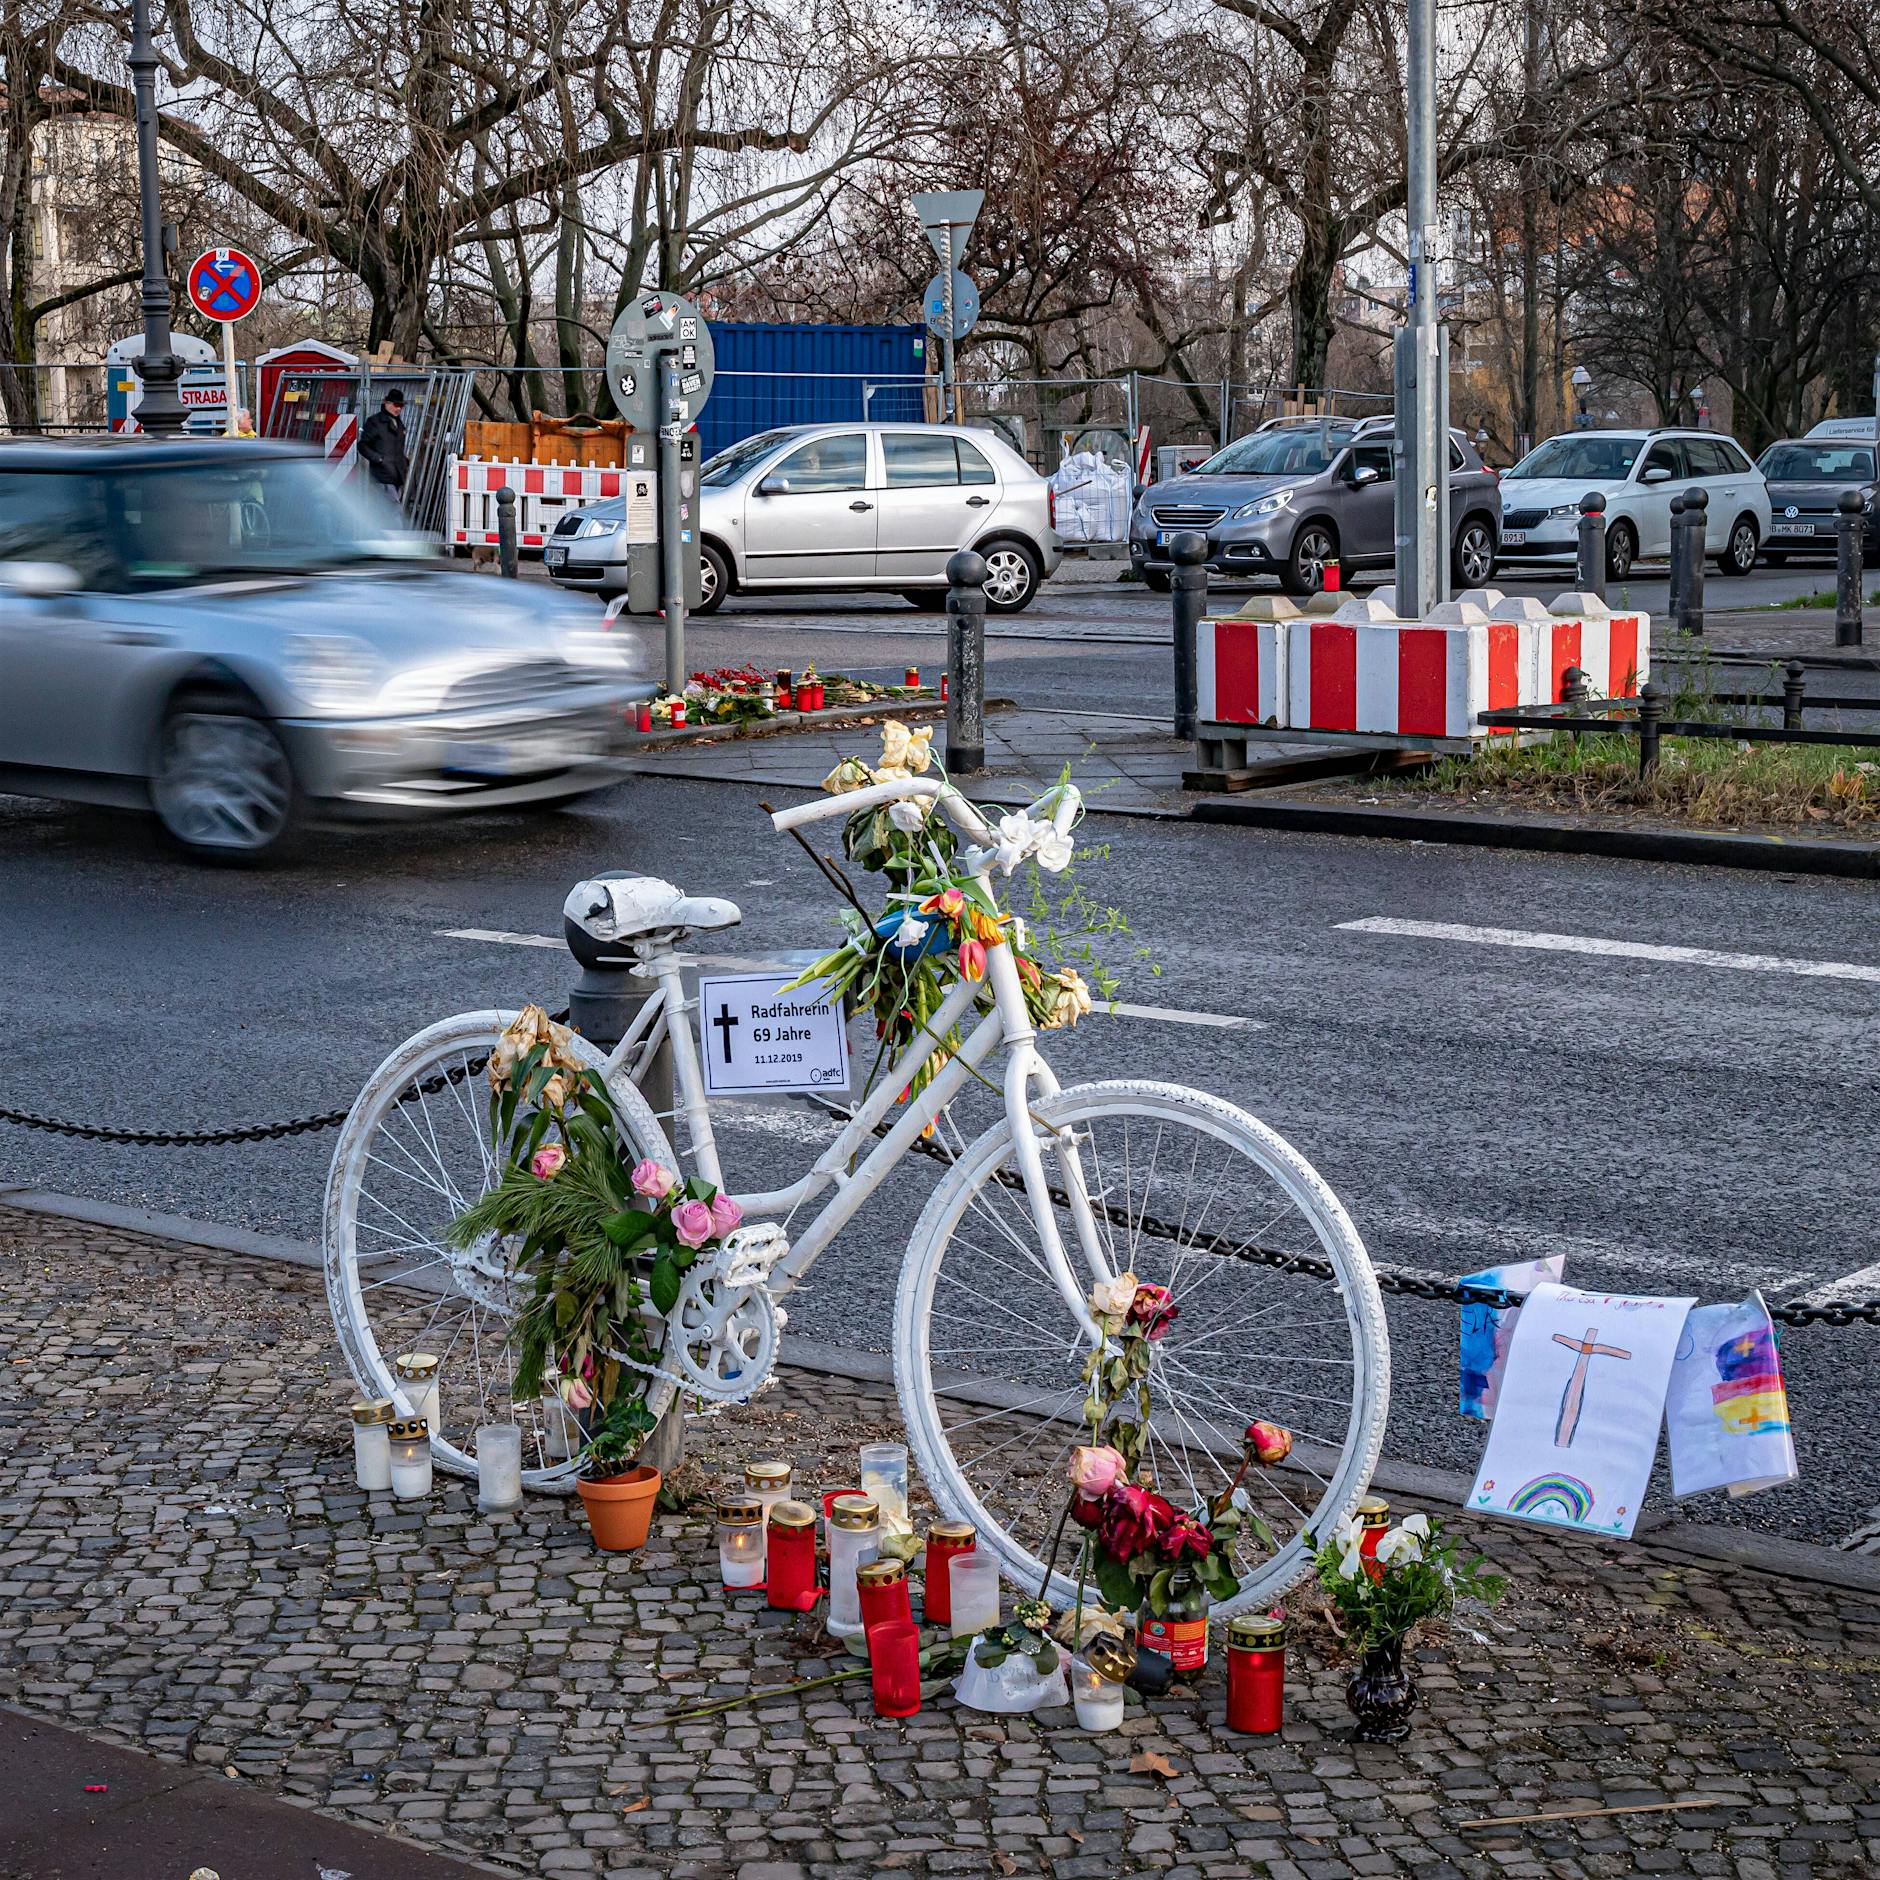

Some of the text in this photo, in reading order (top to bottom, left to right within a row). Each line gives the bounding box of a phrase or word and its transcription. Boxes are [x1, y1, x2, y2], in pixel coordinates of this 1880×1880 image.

[683, 328, 695, 337] OK
[182, 390, 227, 405] STRABA
[1504, 533, 1523, 543] 8913
[751, 1002, 829, 1019] Radfahrerin
[753, 1026, 811, 1042] 69 Jahre
[754, 1053, 803, 1064] 11.12.2019
[822, 1068, 841, 1077] adfc
